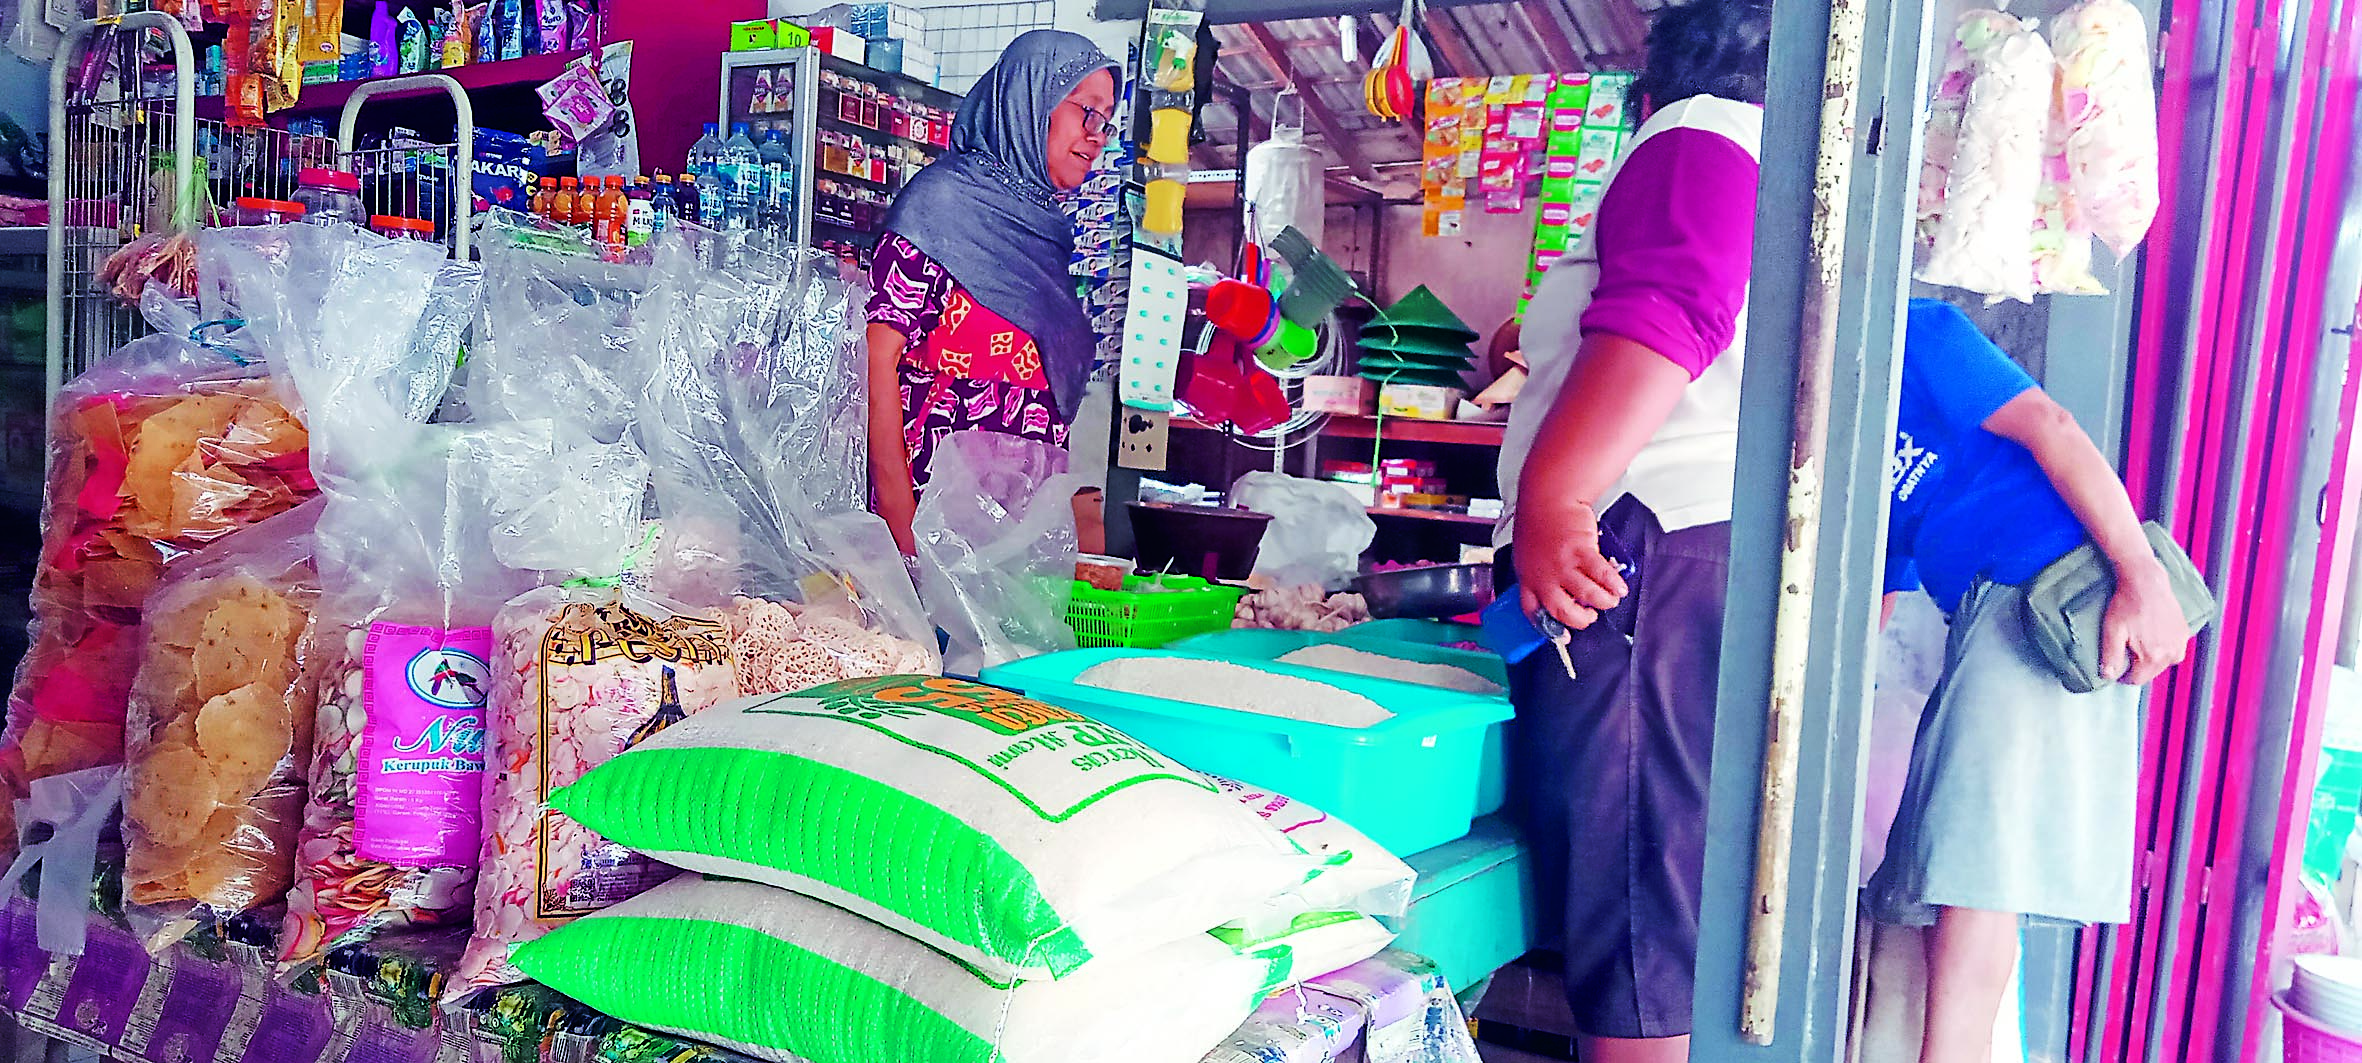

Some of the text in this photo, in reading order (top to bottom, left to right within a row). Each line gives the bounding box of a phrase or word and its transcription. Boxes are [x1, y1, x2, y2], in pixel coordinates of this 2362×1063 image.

[787, 31, 802, 47] 10
[471, 159, 526, 181] AKAR
[381, 758, 450, 774] Kerupuk
